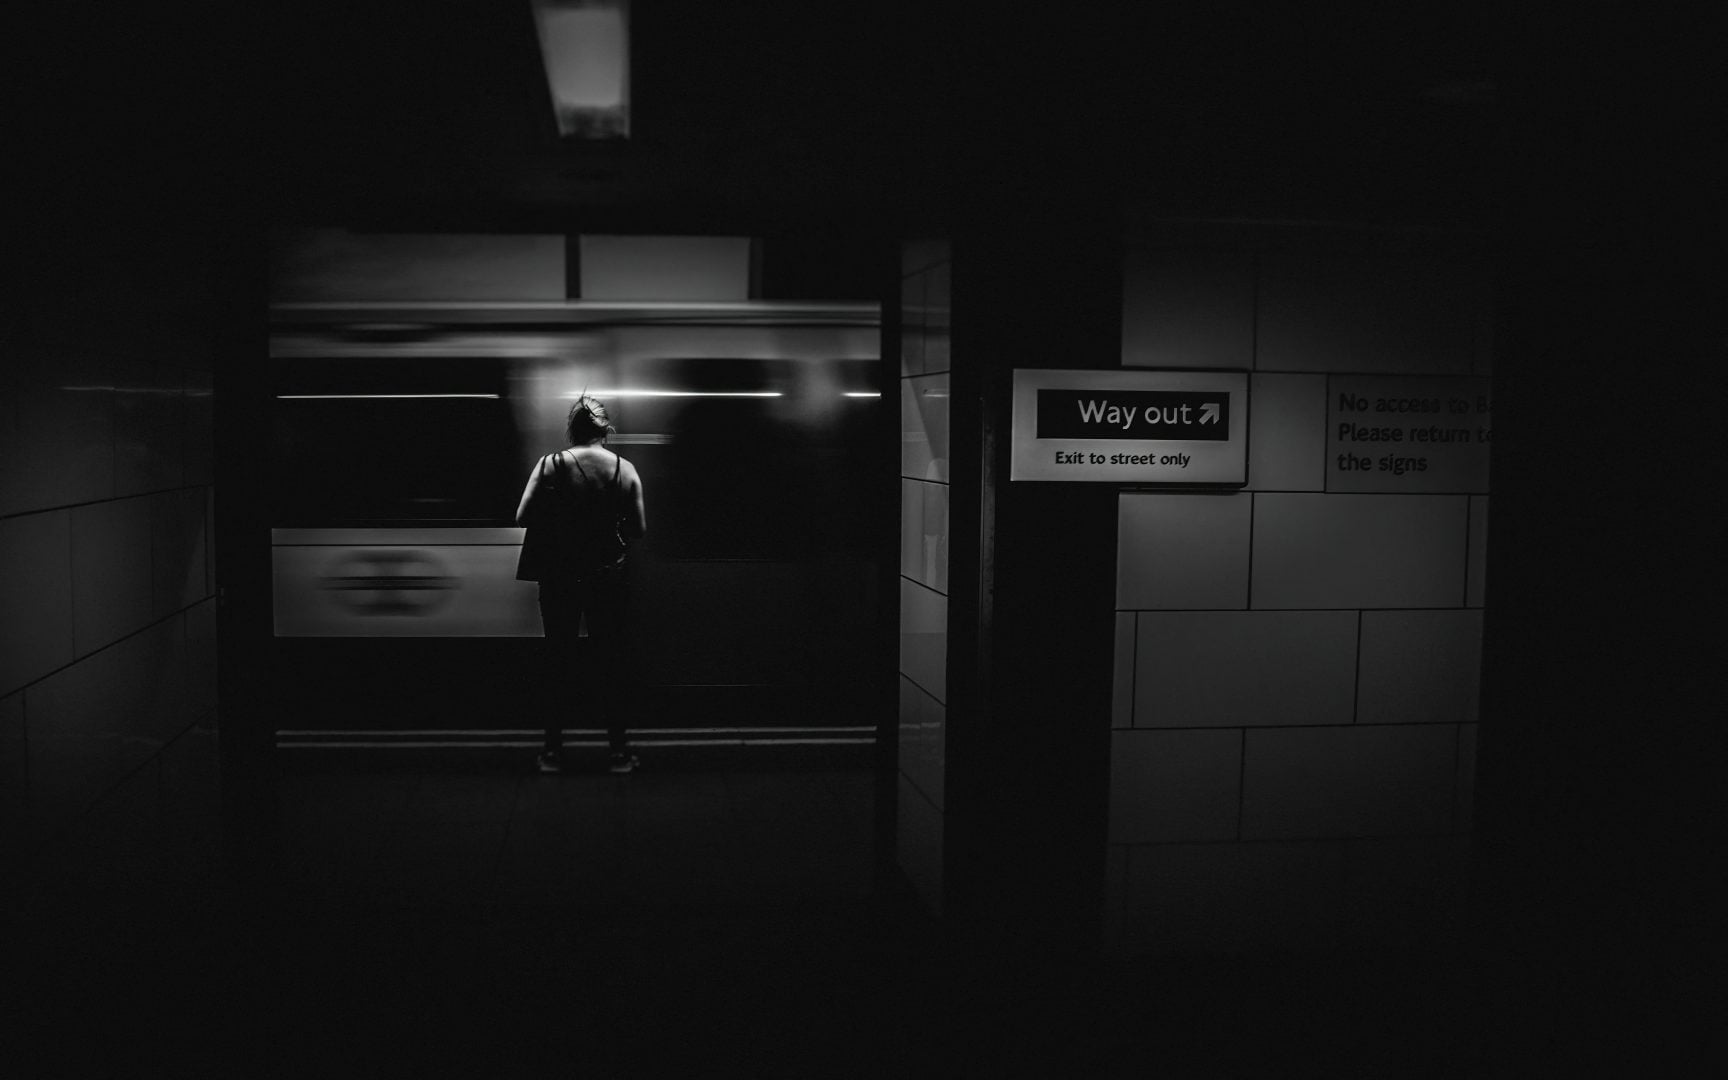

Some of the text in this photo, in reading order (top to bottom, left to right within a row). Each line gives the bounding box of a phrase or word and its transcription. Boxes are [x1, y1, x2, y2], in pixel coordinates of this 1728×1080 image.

[1338, 392, 1369, 413] No
[1375, 397, 1441, 414] access
[1447, 396, 1471, 414] to
[1078, 400, 1192, 430] Way out
[1338, 422, 1404, 442] Please
[1410, 425, 1471, 443] return
[1055, 451, 1191, 468] Exit to street only
[1337, 452, 1428, 476] the signs
